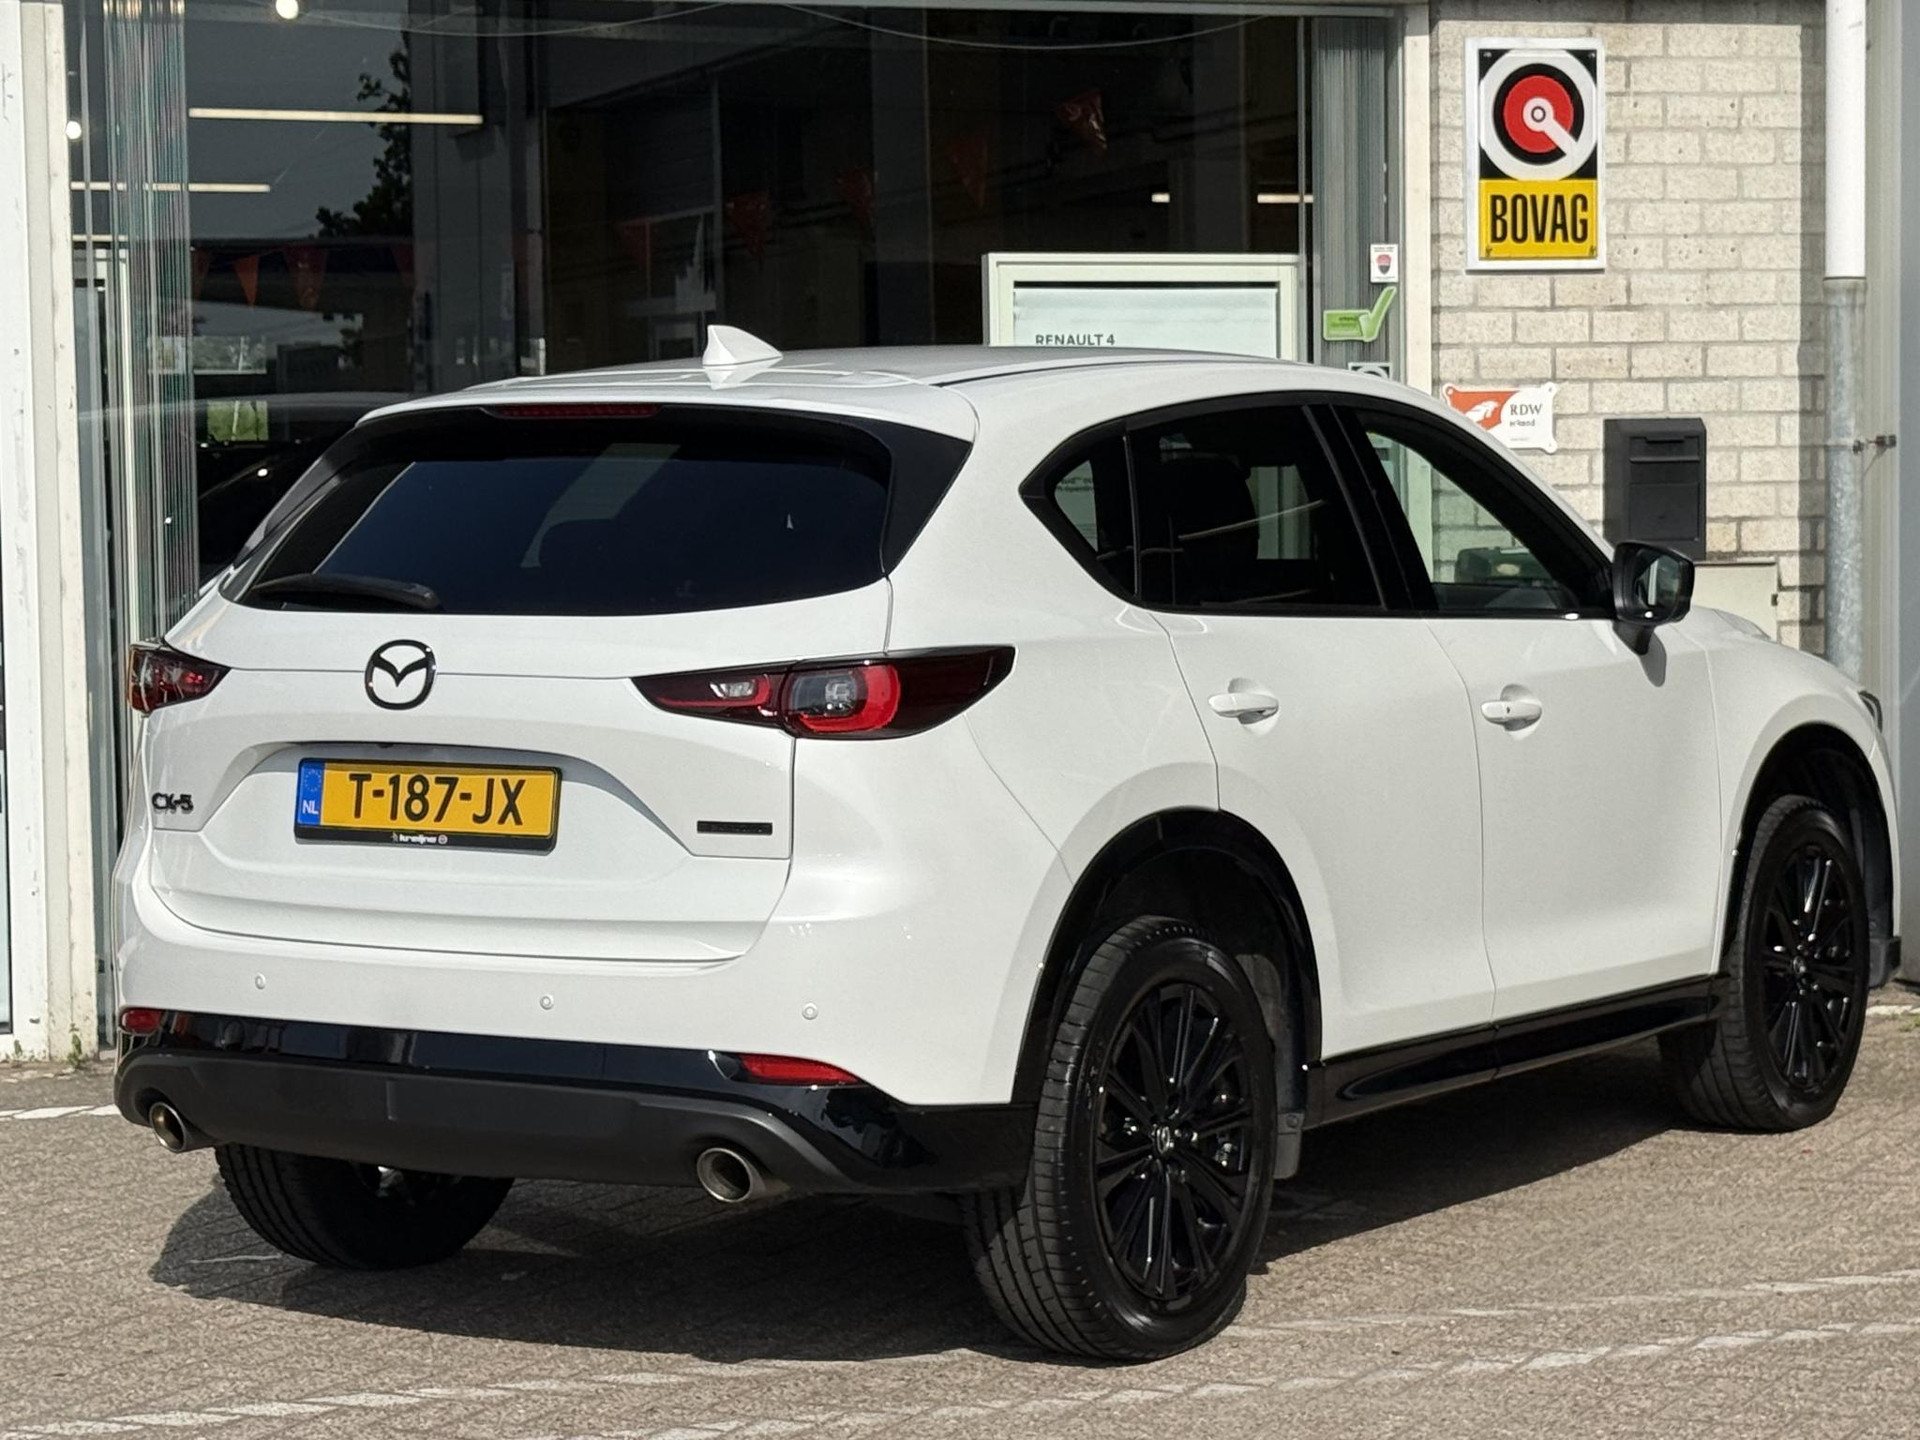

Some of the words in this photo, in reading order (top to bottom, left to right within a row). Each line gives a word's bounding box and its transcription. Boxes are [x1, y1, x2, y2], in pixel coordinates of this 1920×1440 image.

[1490, 193, 1589, 243] BOVAG
[1035, 333, 1103, 346] RENAULT
[1106, 333, 1115, 346] 4
[1510, 403, 1543, 416] RDW
[151, 792, 194, 811] CX-5
[348, 773, 526, 826] T-187-JX
[302, 802, 319, 815] NL
